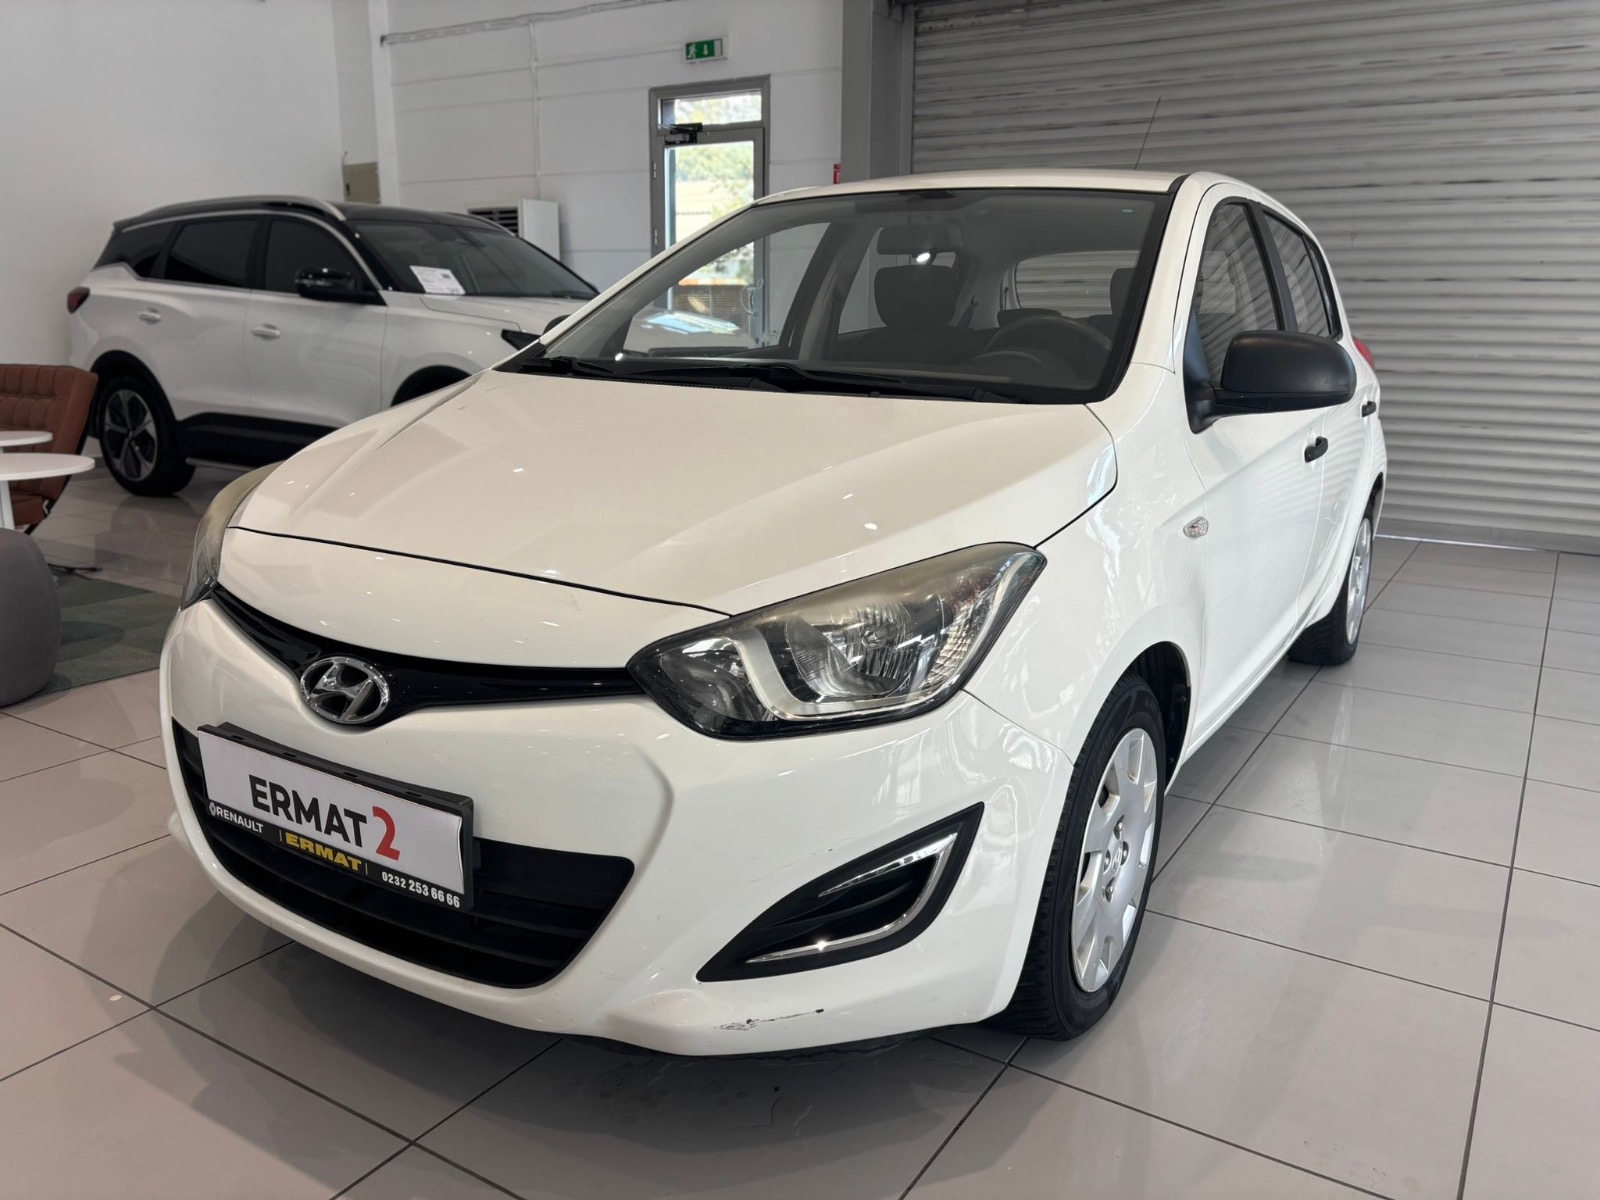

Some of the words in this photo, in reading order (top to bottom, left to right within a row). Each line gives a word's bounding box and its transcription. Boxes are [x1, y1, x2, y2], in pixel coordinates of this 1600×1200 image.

[216, 807, 264, 834] RENAULT
[285, 832, 361, 871] ERMAT
[382, 871, 407, 889] 0232
[409, 880, 429, 898] 253
